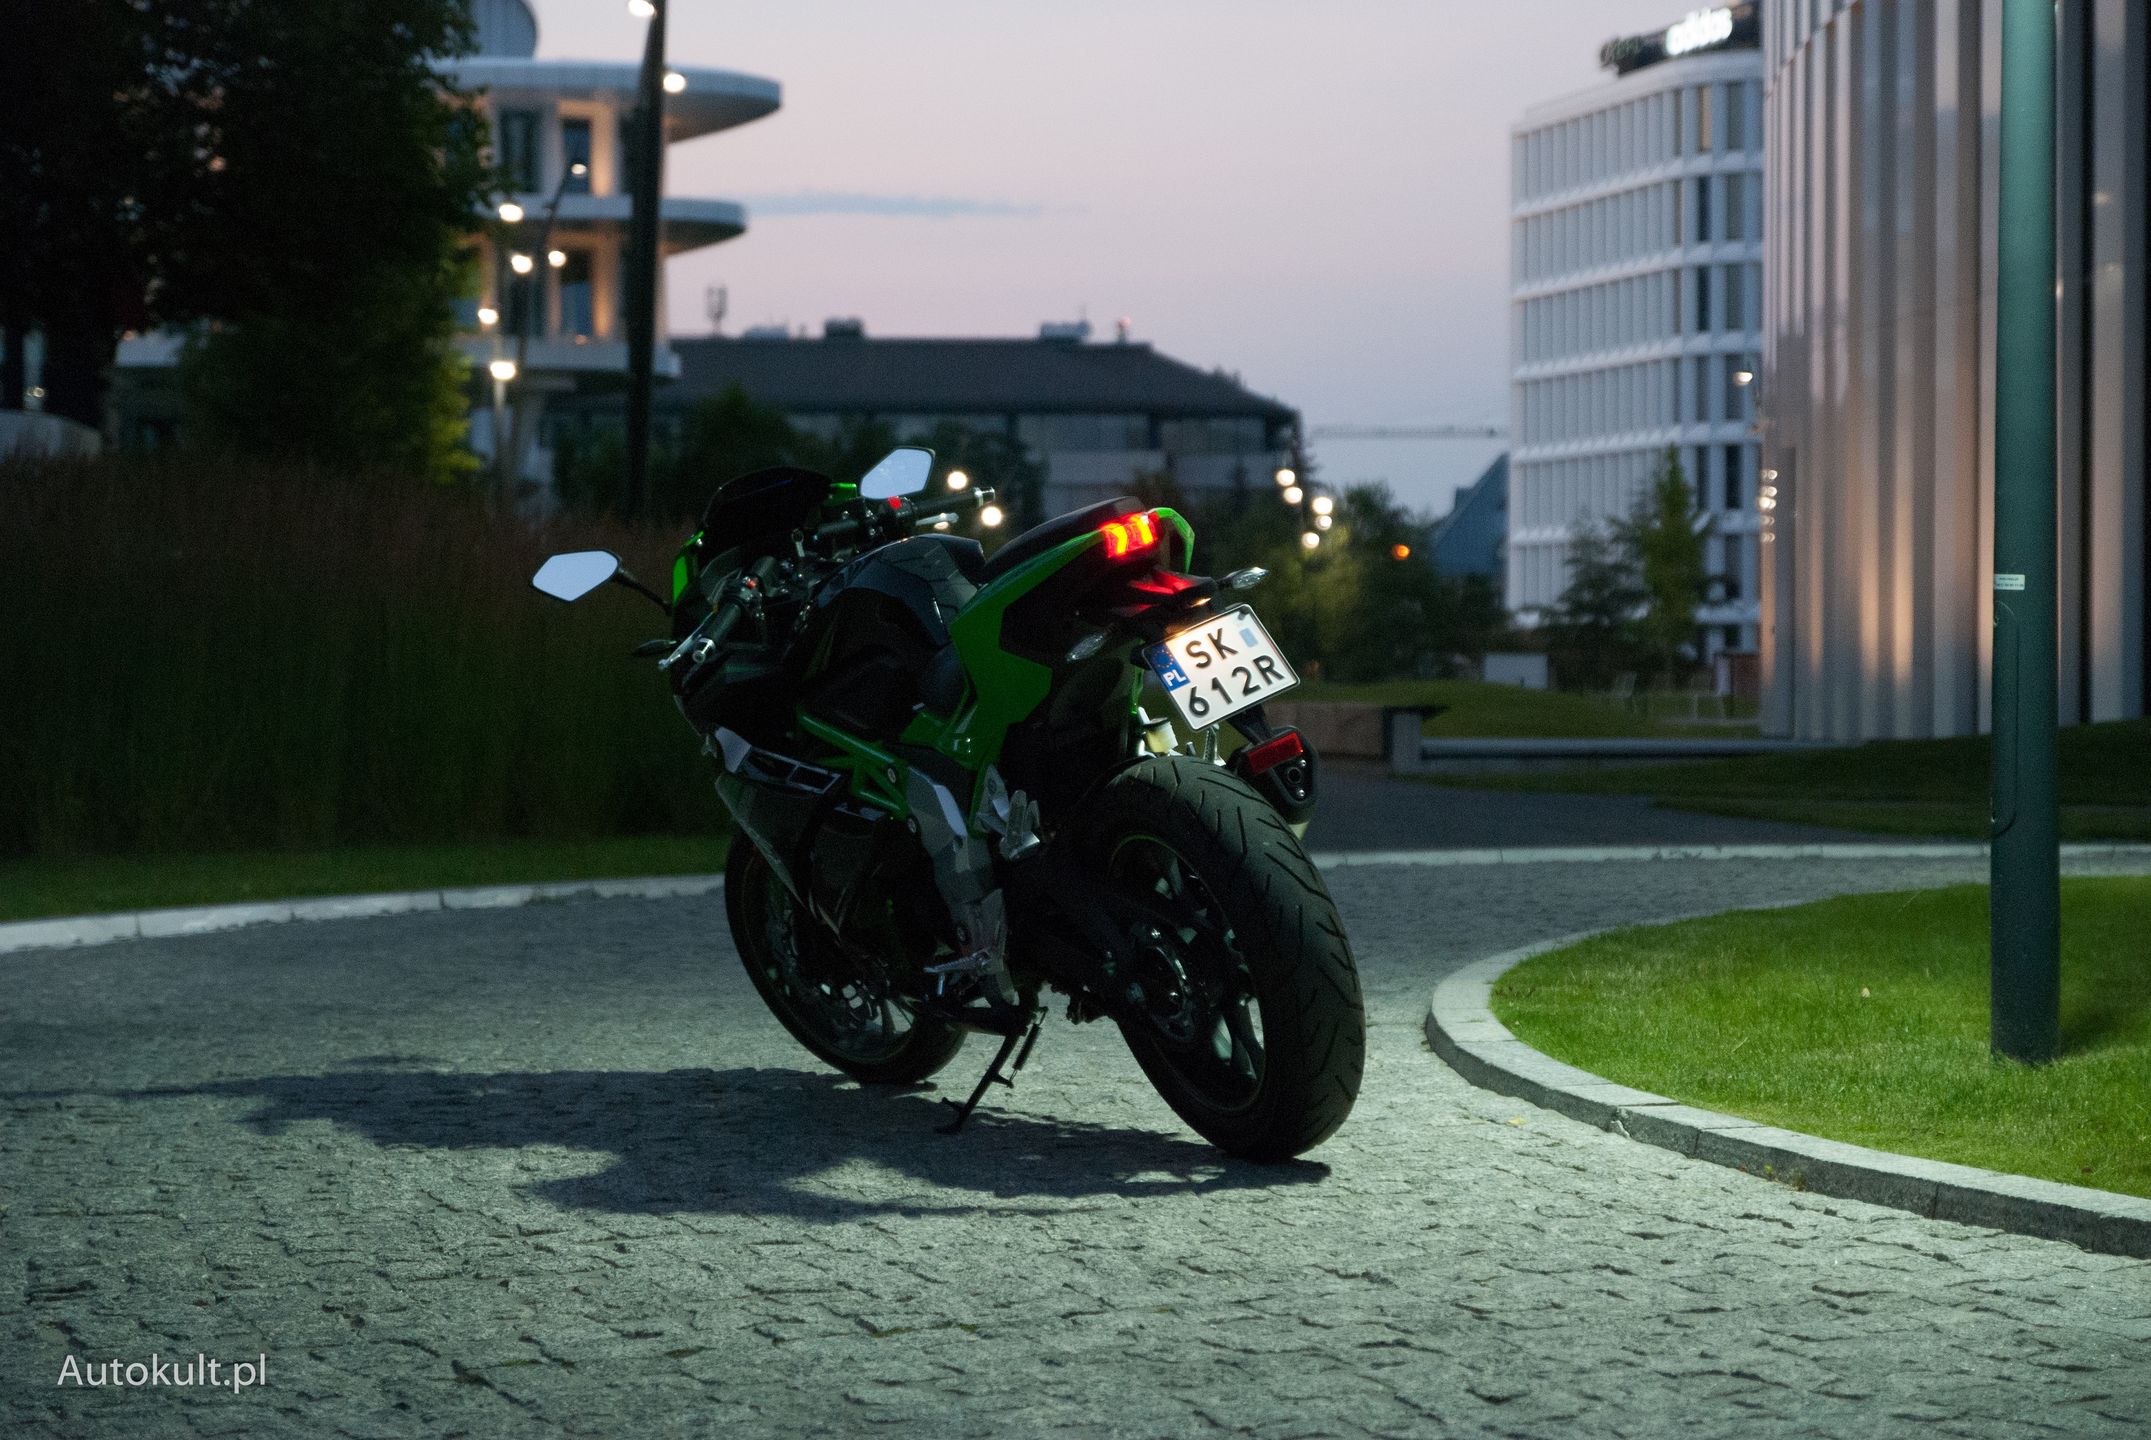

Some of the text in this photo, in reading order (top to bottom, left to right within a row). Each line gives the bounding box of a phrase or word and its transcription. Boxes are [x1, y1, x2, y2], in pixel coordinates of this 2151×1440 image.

[1186, 628, 1238, 669] SK
[1163, 669, 1187, 687] PL
[1189, 655, 1285, 717] 612R
